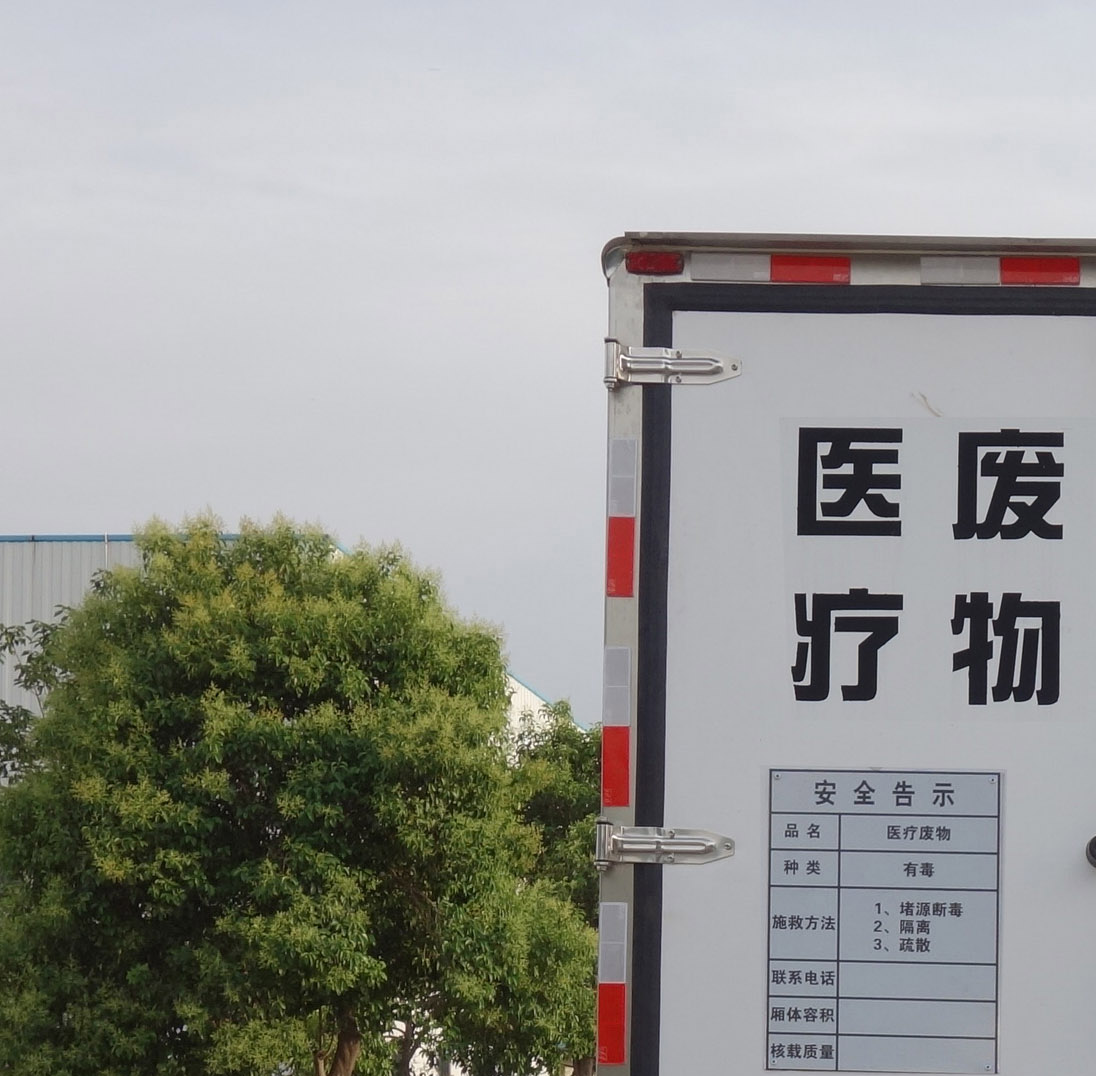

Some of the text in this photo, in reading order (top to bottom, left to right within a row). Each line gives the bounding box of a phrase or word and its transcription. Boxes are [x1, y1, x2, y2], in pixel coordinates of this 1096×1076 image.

[791, 427, 903, 702] 医疗
[950, 428, 1065, 705] 废物
[814, 779, 955, 808] 安全告示
[784, 823, 822, 839] 品名
[886, 825, 951, 841] 医疗废物
[783, 859, 821, 875] 种类
[903, 861, 935, 878] 有毒
[772, 914, 836, 931] 施救方法
[771, 969, 836, 987] 联系电话
[770, 1006, 835, 1024] 厢体容积
[770, 1043, 835, 1060] 核载质量
